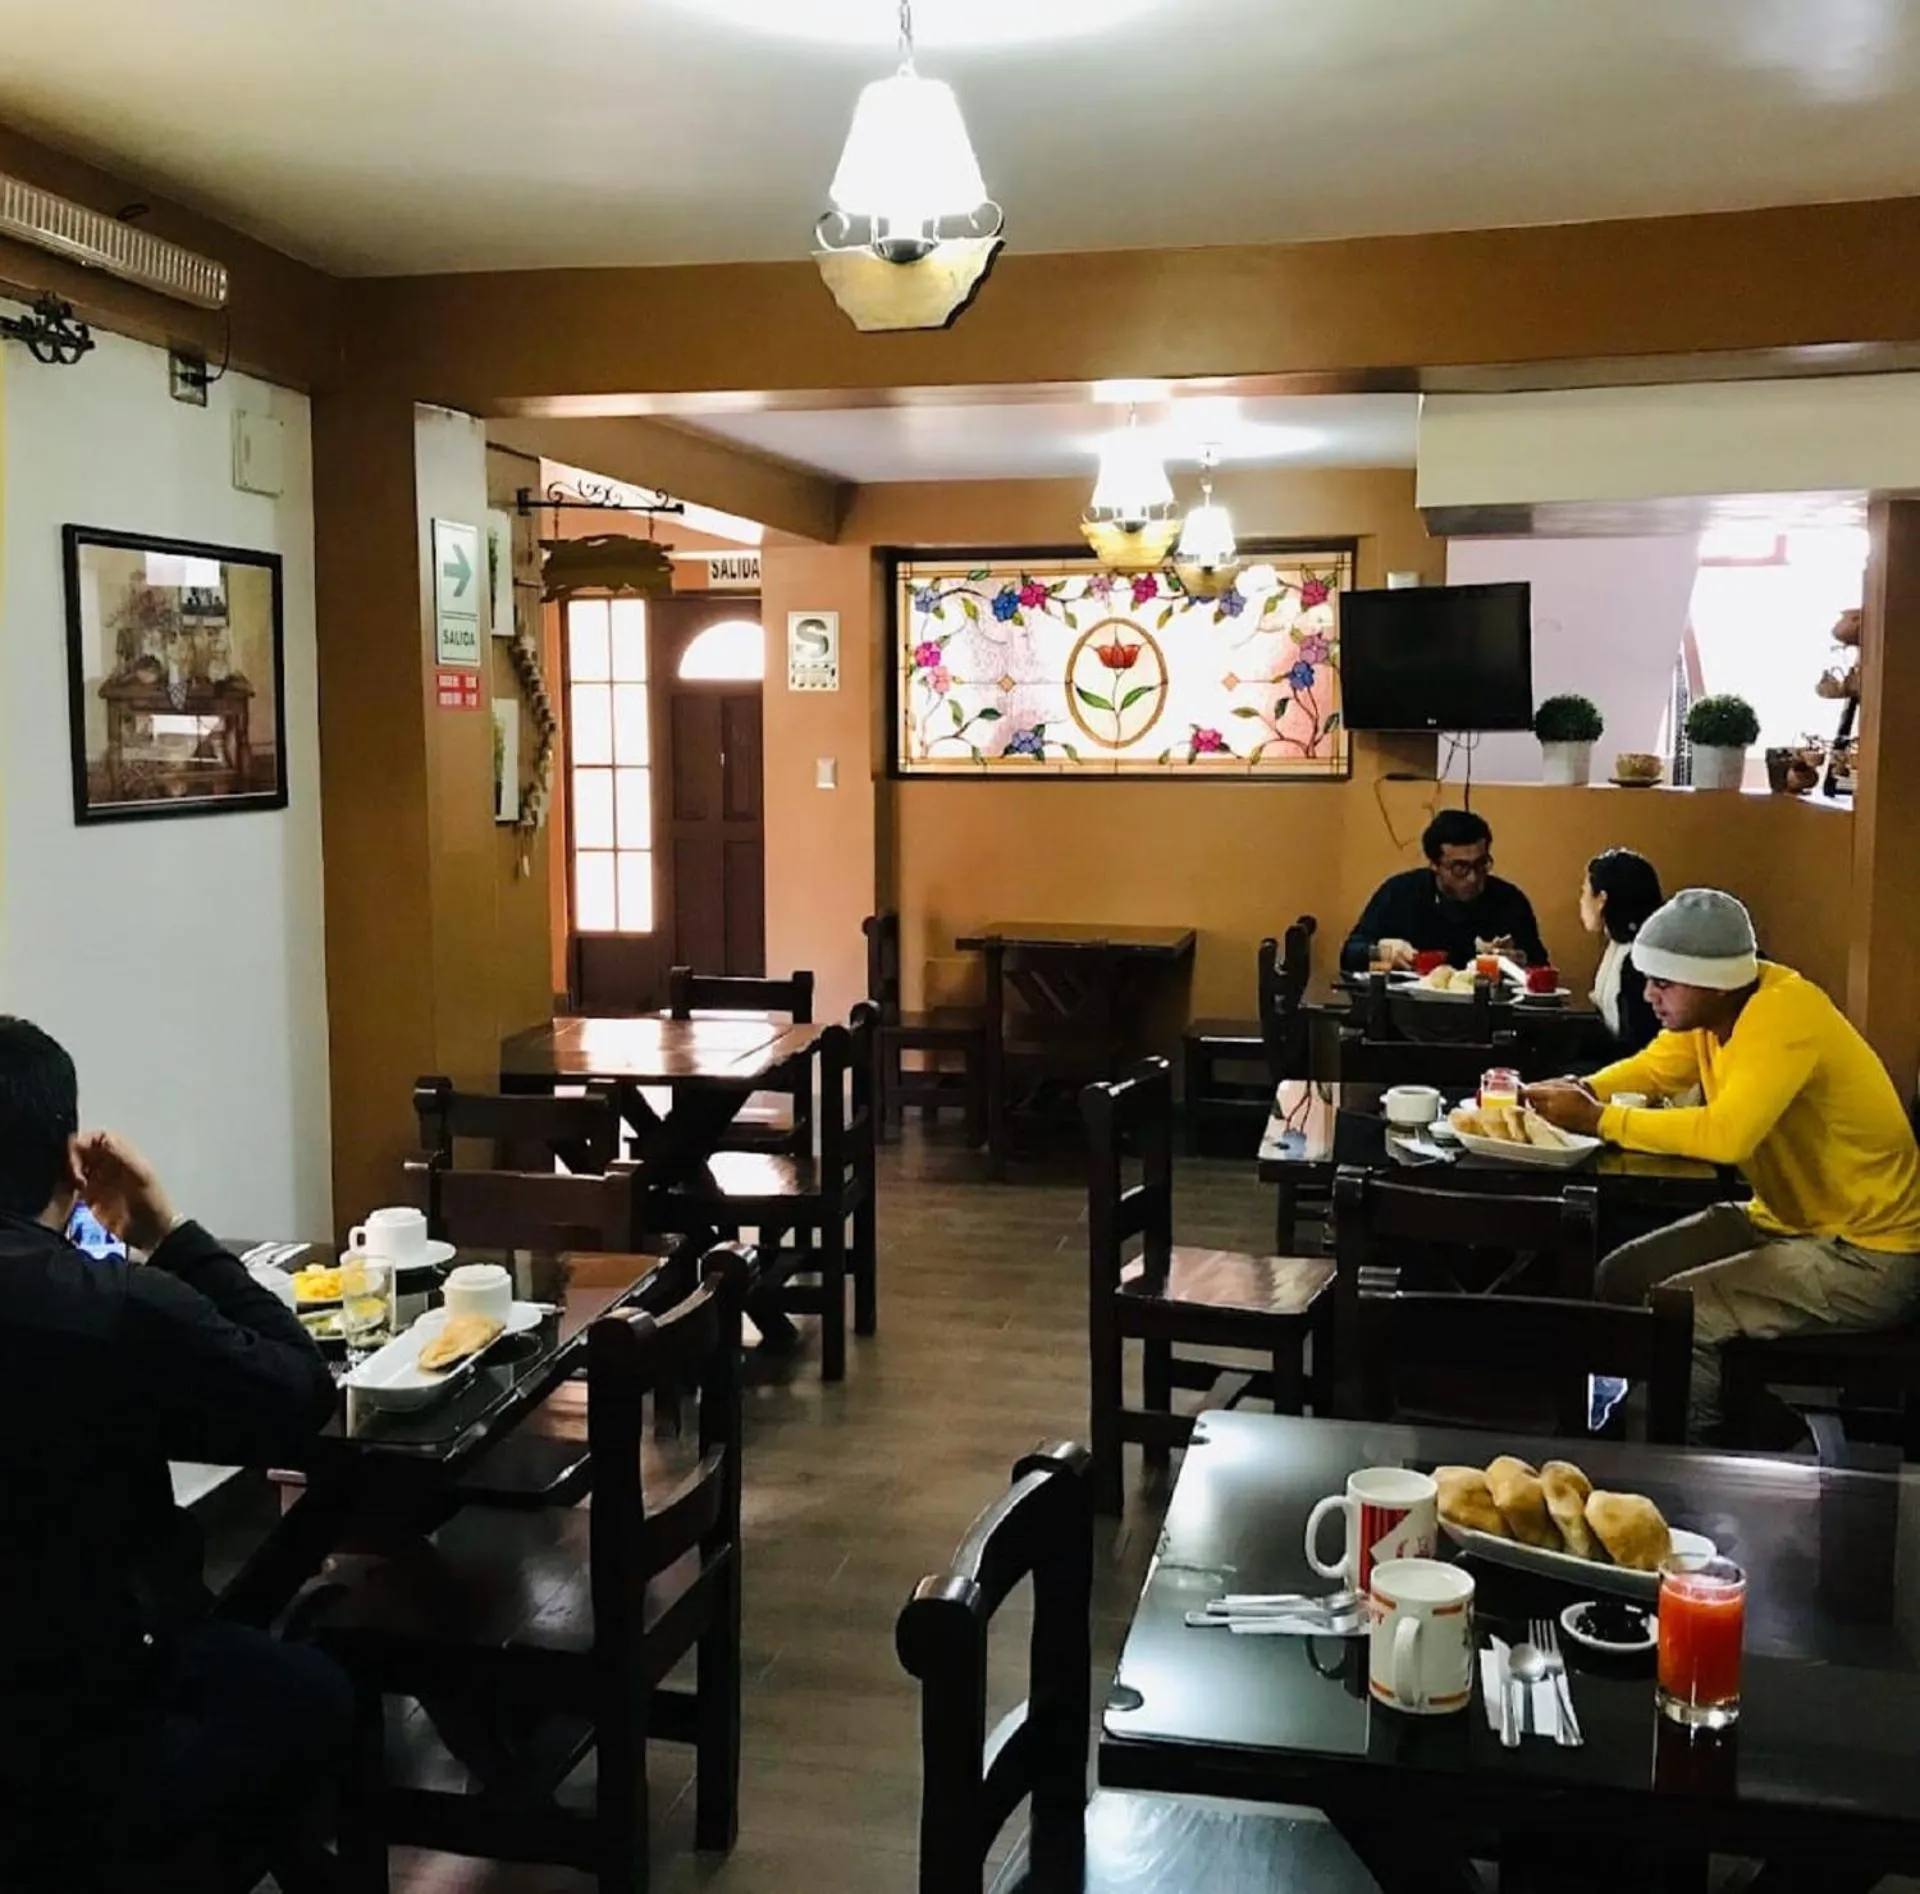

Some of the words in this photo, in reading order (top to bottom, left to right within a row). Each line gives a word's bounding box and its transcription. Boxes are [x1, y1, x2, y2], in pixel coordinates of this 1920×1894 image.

[711, 558, 760, 579] SALIDA
[443, 628, 475, 646] SALIDA
[796, 618, 829, 658] S
